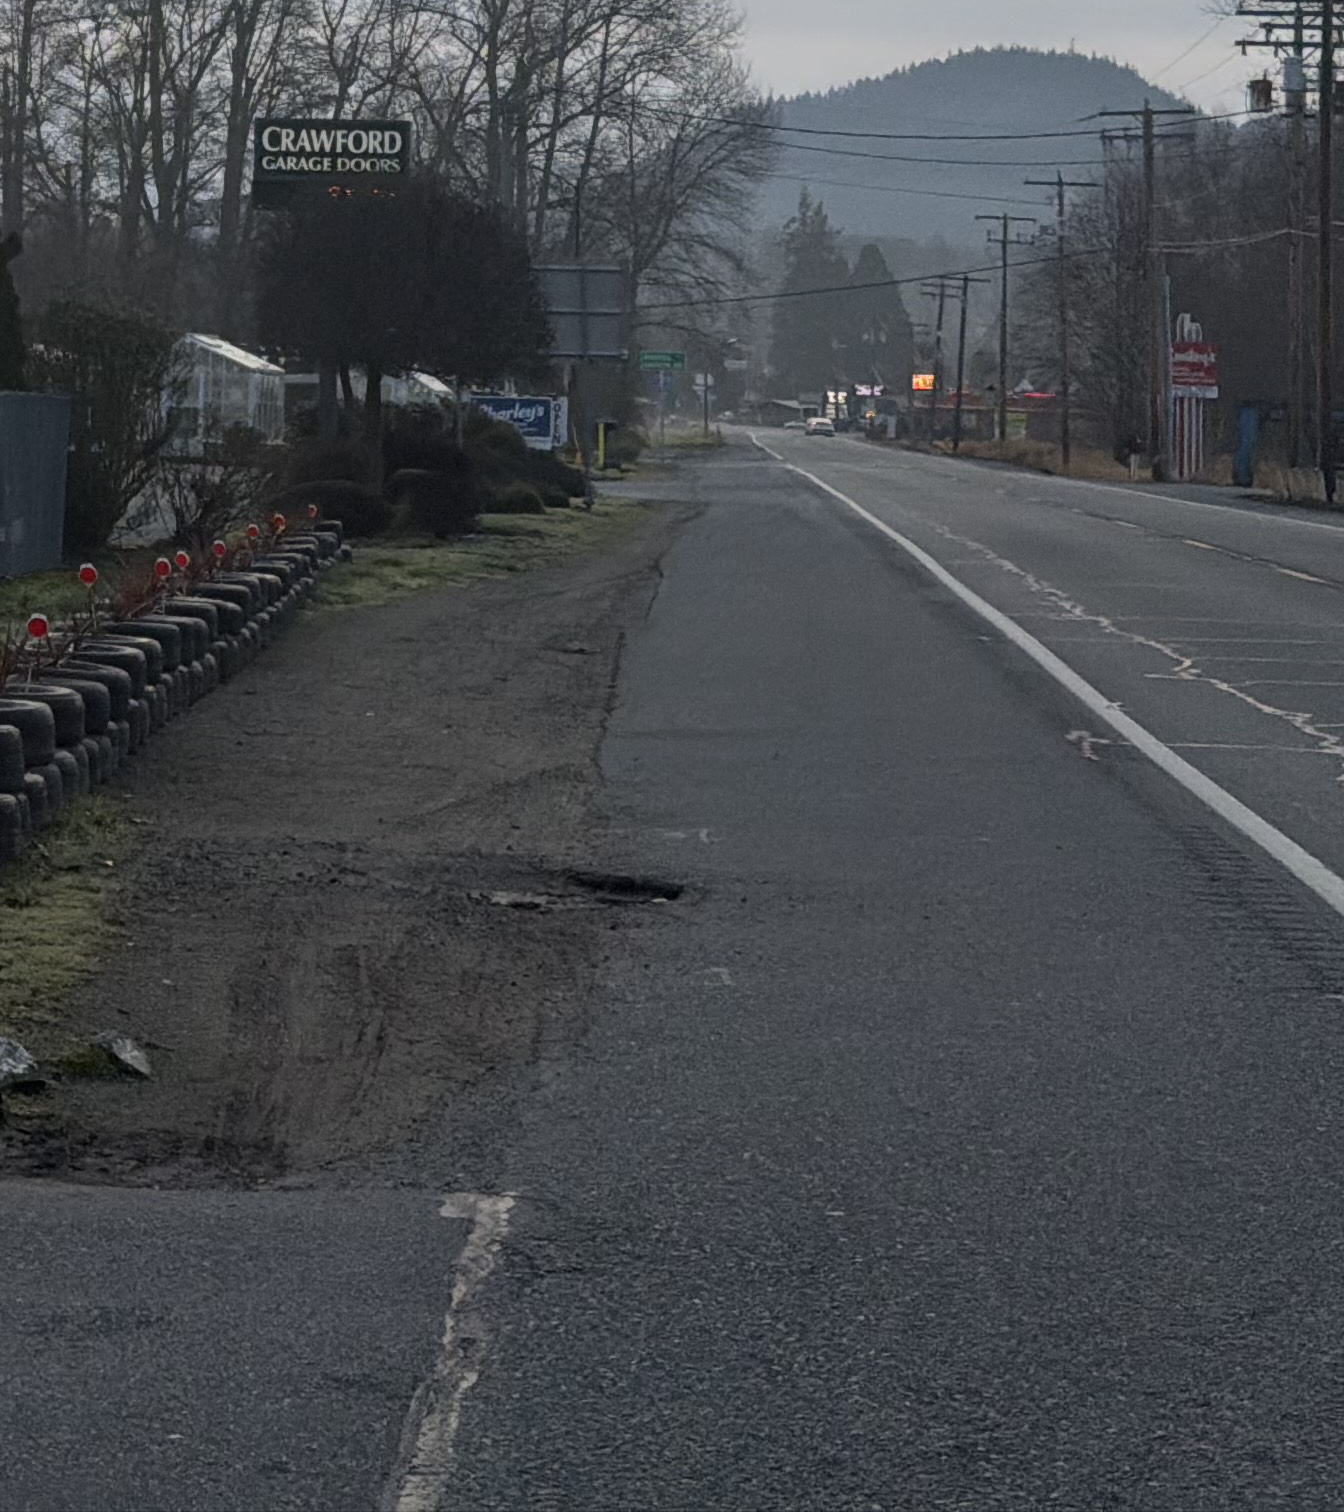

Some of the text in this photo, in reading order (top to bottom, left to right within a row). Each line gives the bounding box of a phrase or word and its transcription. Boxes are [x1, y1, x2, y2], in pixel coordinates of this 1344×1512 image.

[262, 126, 402, 154] CRAWFORD
[262, 156, 401, 173] GARAGE DOORS
